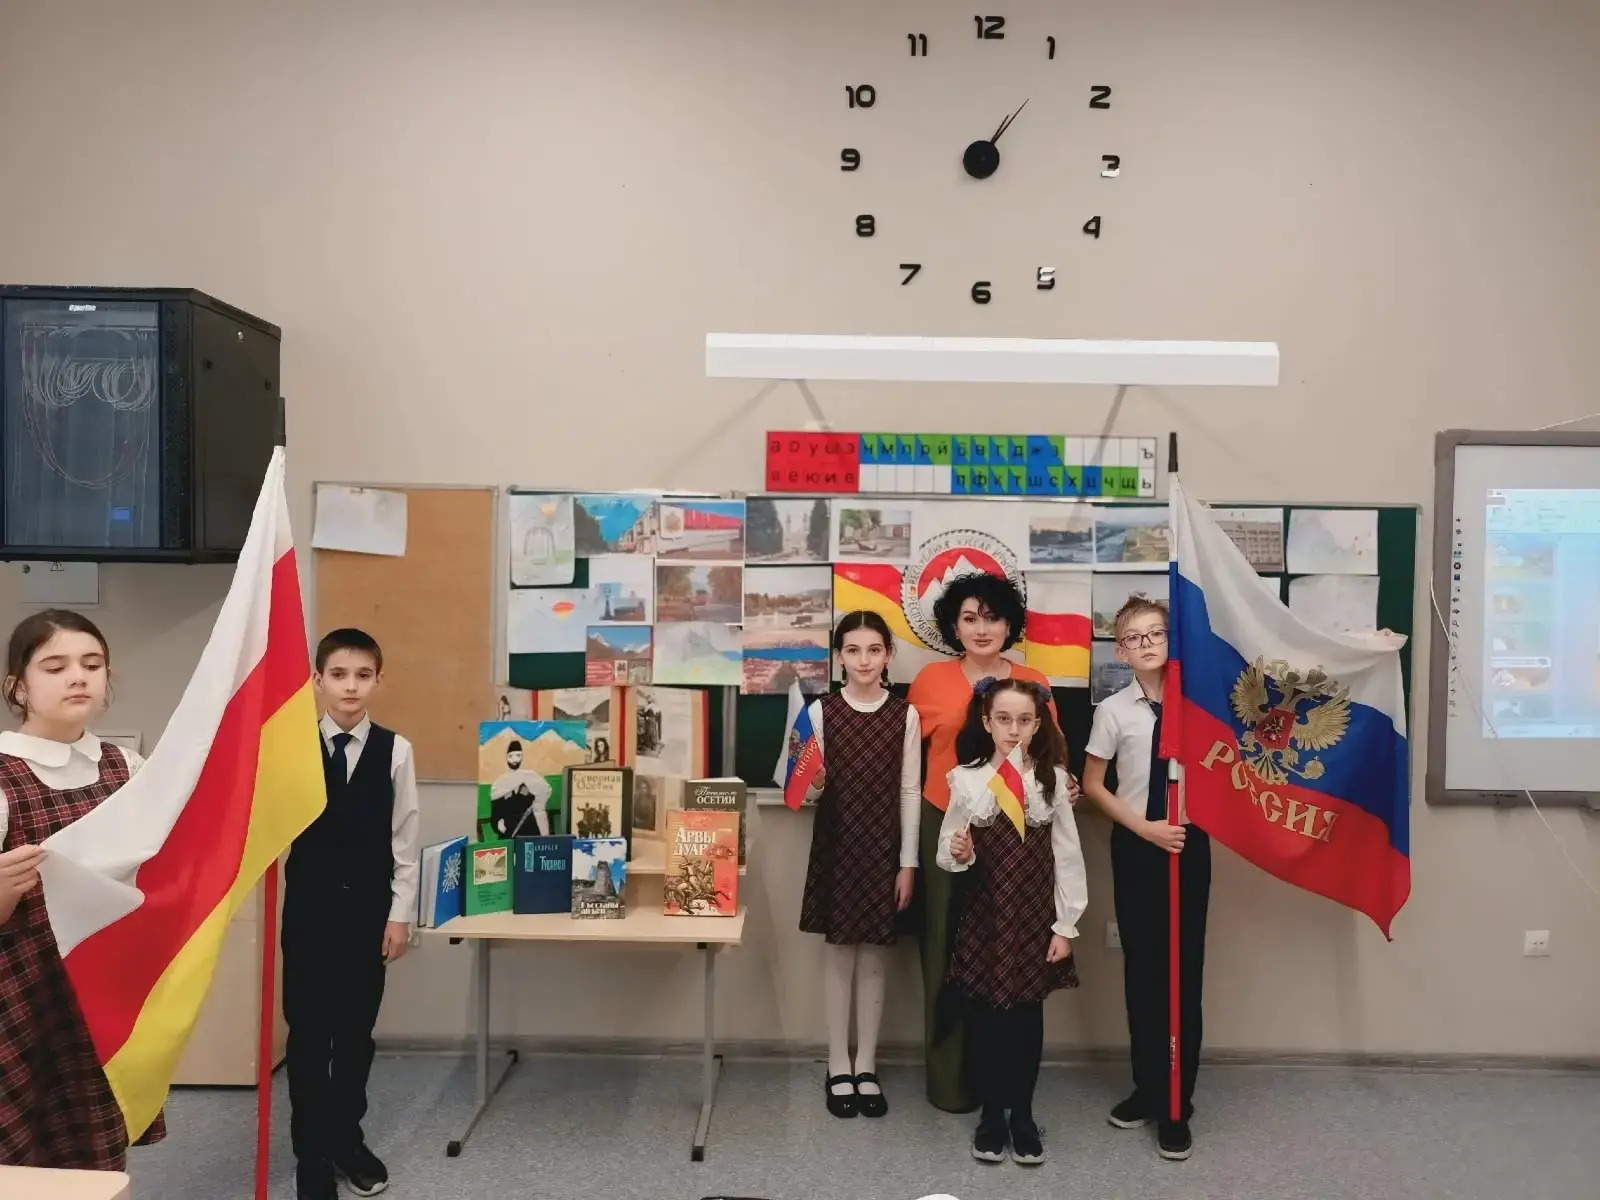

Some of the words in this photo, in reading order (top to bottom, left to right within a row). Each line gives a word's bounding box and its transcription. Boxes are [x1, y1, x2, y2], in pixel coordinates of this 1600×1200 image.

[975, 16, 1005, 39] 12
[908, 33, 928, 56] 11
[1047, 36, 1056, 59] 1
[846, 84, 876, 108] 10
[1089, 86, 1111, 109] 2
[841, 148, 861, 171] 9
[1101, 155, 1120, 177] 3
[856, 215, 875, 237] 8
[1082, 216, 1101, 238] 4
[899, 264, 922, 285] 7
[1037, 267, 1056, 289] 5
[971, 281, 992, 304] 6
[1104, 476, 1114, 488] ч
[696, 795, 736, 805] ОСЕТИИ
[672, 843, 709, 856] ДУАР
